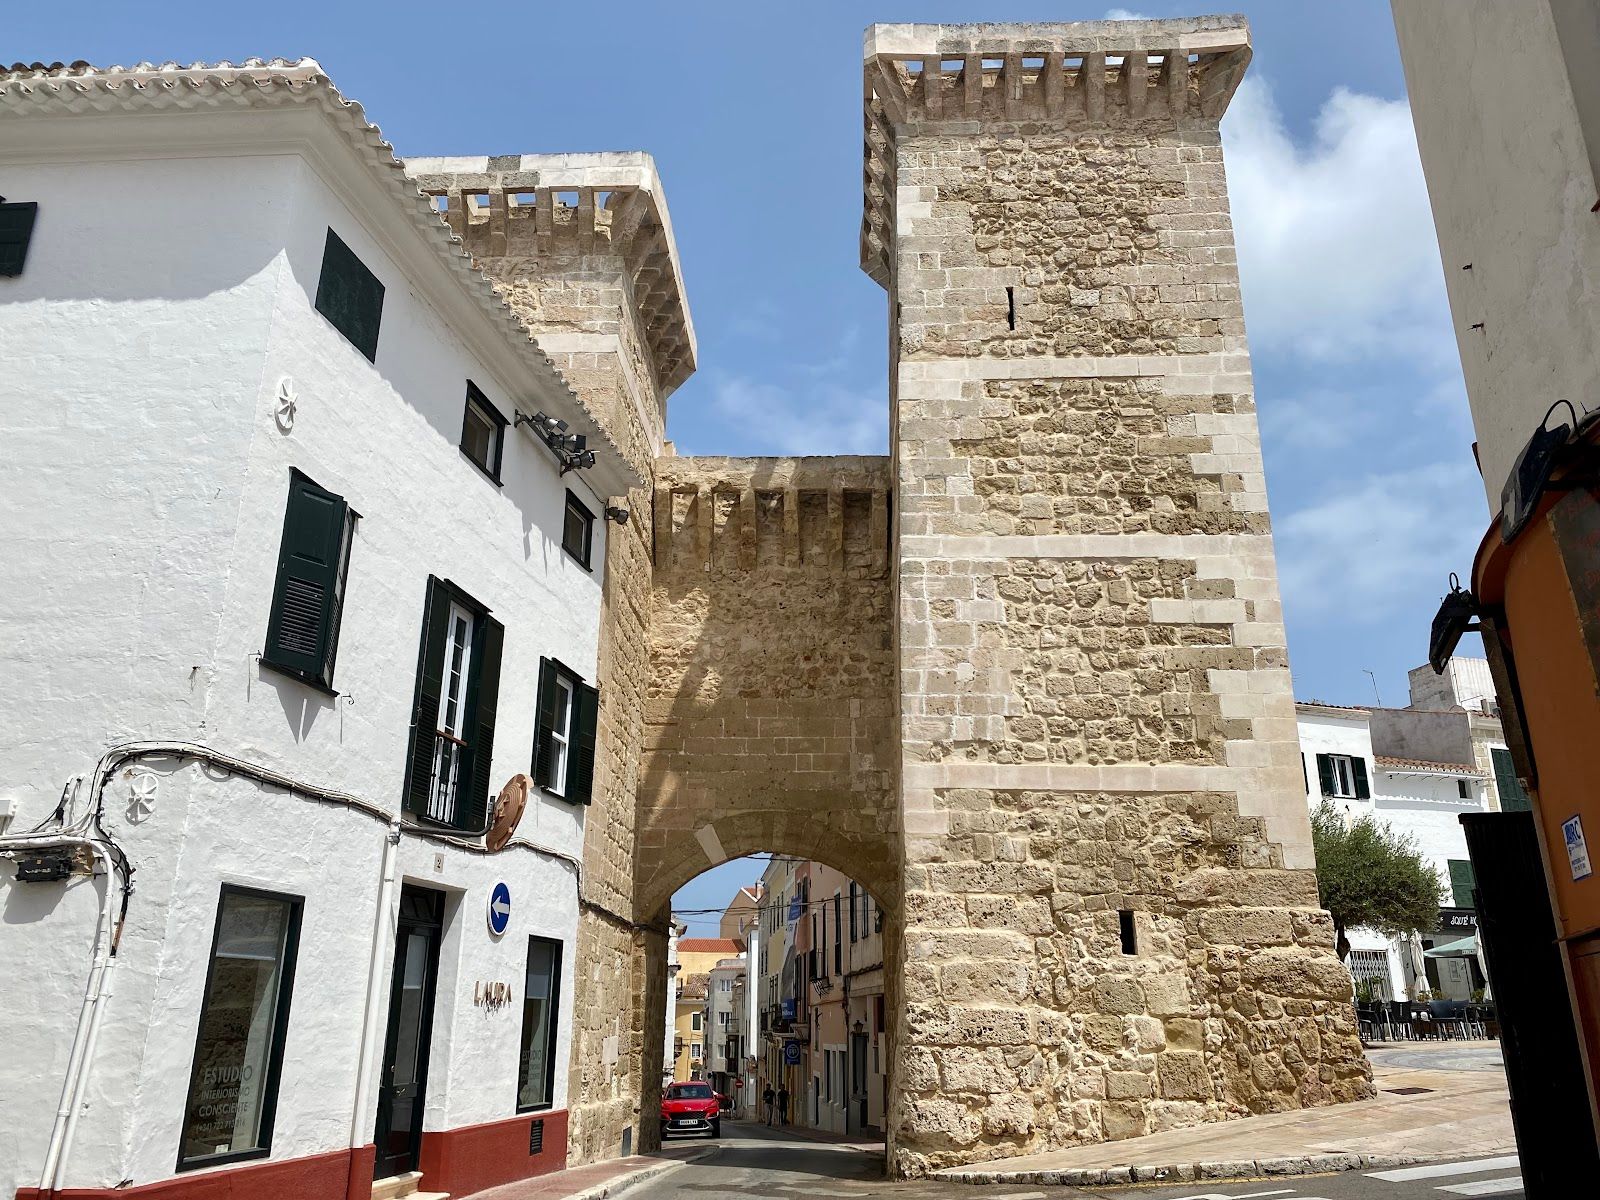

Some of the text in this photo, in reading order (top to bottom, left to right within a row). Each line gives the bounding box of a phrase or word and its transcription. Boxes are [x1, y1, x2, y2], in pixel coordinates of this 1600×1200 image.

[437, 858, 441, 869] 2
[474, 981, 512, 1003] LAURA
[203, 1065, 252, 1085] ESTUDIO
[201, 1086, 250, 1100] INTERIORISMO
[199, 1102, 248, 1117] CONSCIENTE
